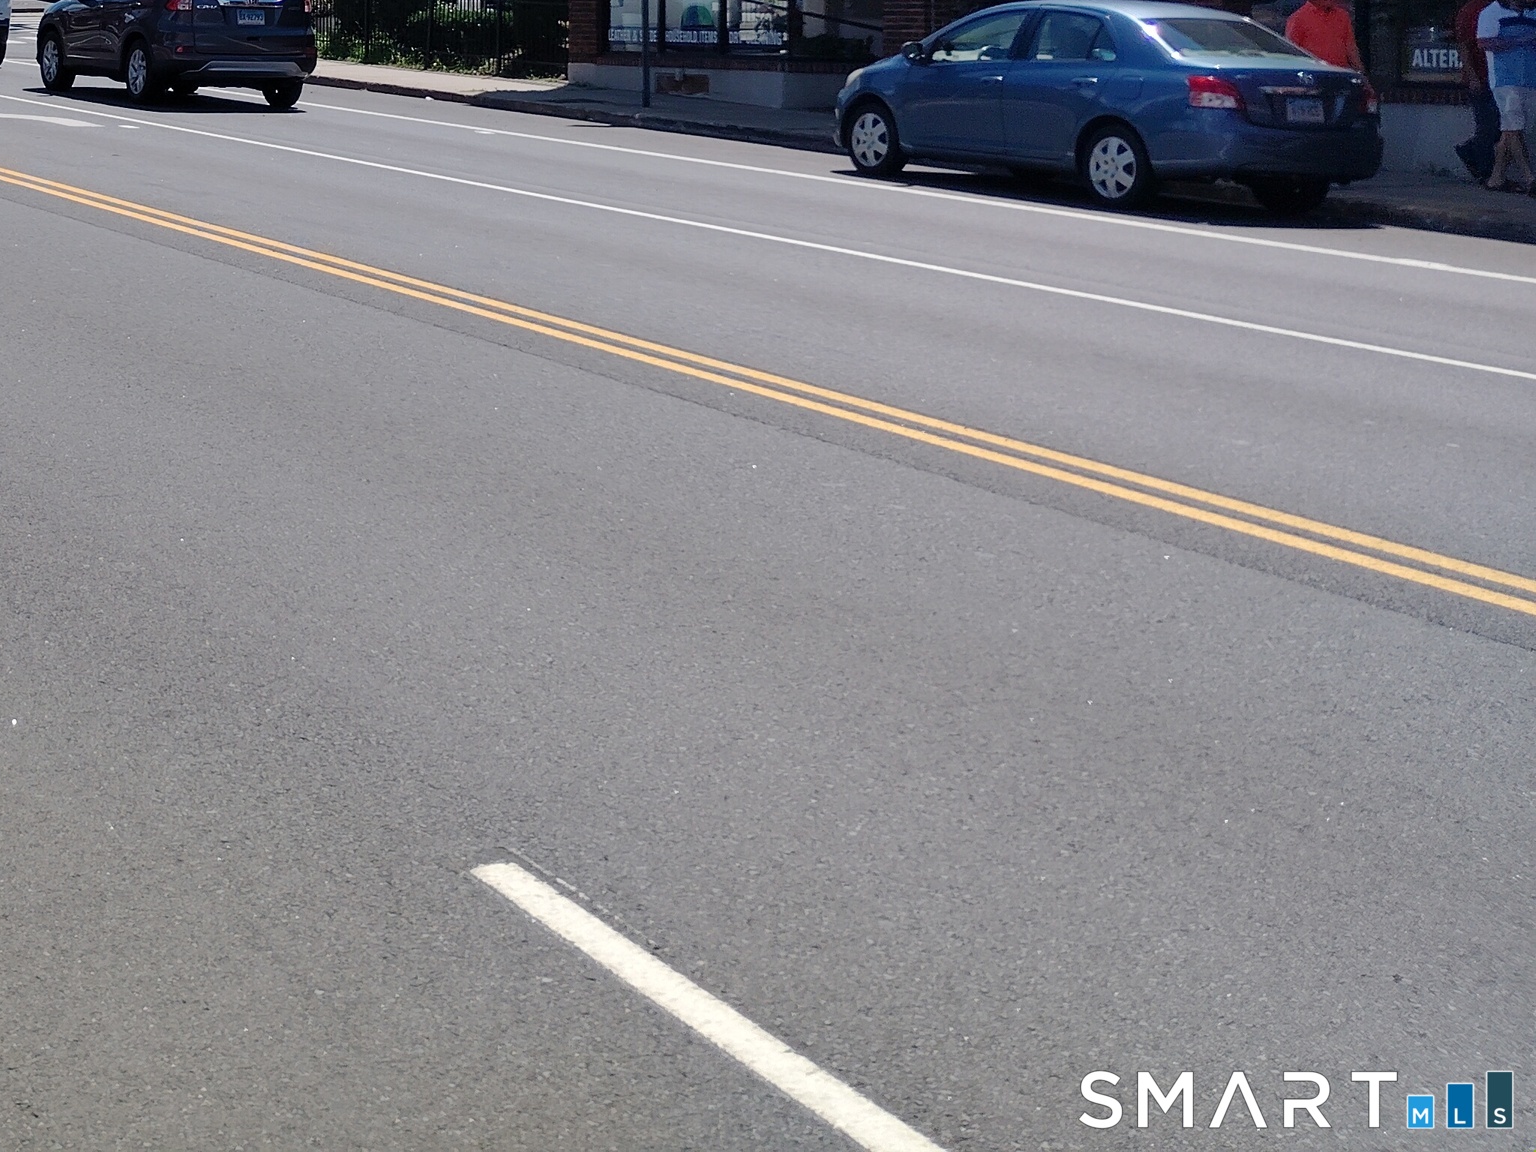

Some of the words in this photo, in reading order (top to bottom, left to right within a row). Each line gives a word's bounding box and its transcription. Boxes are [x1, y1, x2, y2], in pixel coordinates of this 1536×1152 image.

[608, 29, 631, 42] LEATHER
[639, 30, 658, 43] SDE
[665, 30, 698, 44] HOUSEHOLD
[699, 30, 718, 45] ITEMS
[1412, 48, 1463, 69] ALTER
